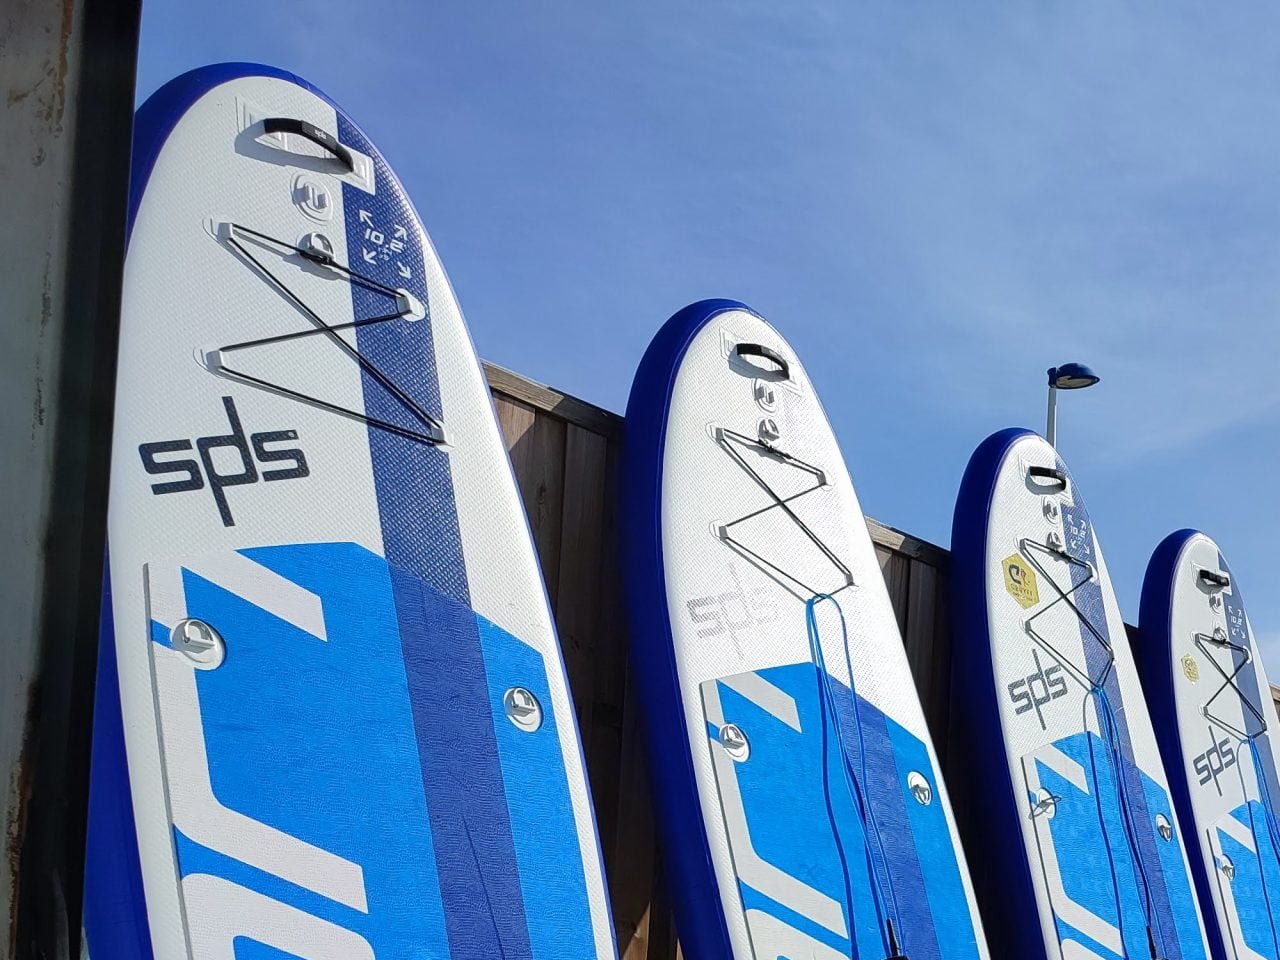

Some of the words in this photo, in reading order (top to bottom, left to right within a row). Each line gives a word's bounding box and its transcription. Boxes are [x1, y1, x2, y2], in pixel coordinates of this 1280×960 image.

[138, 396, 310, 528] sps
[1007, 648, 1069, 732] sps
[1192, 725, 1237, 797] sps
